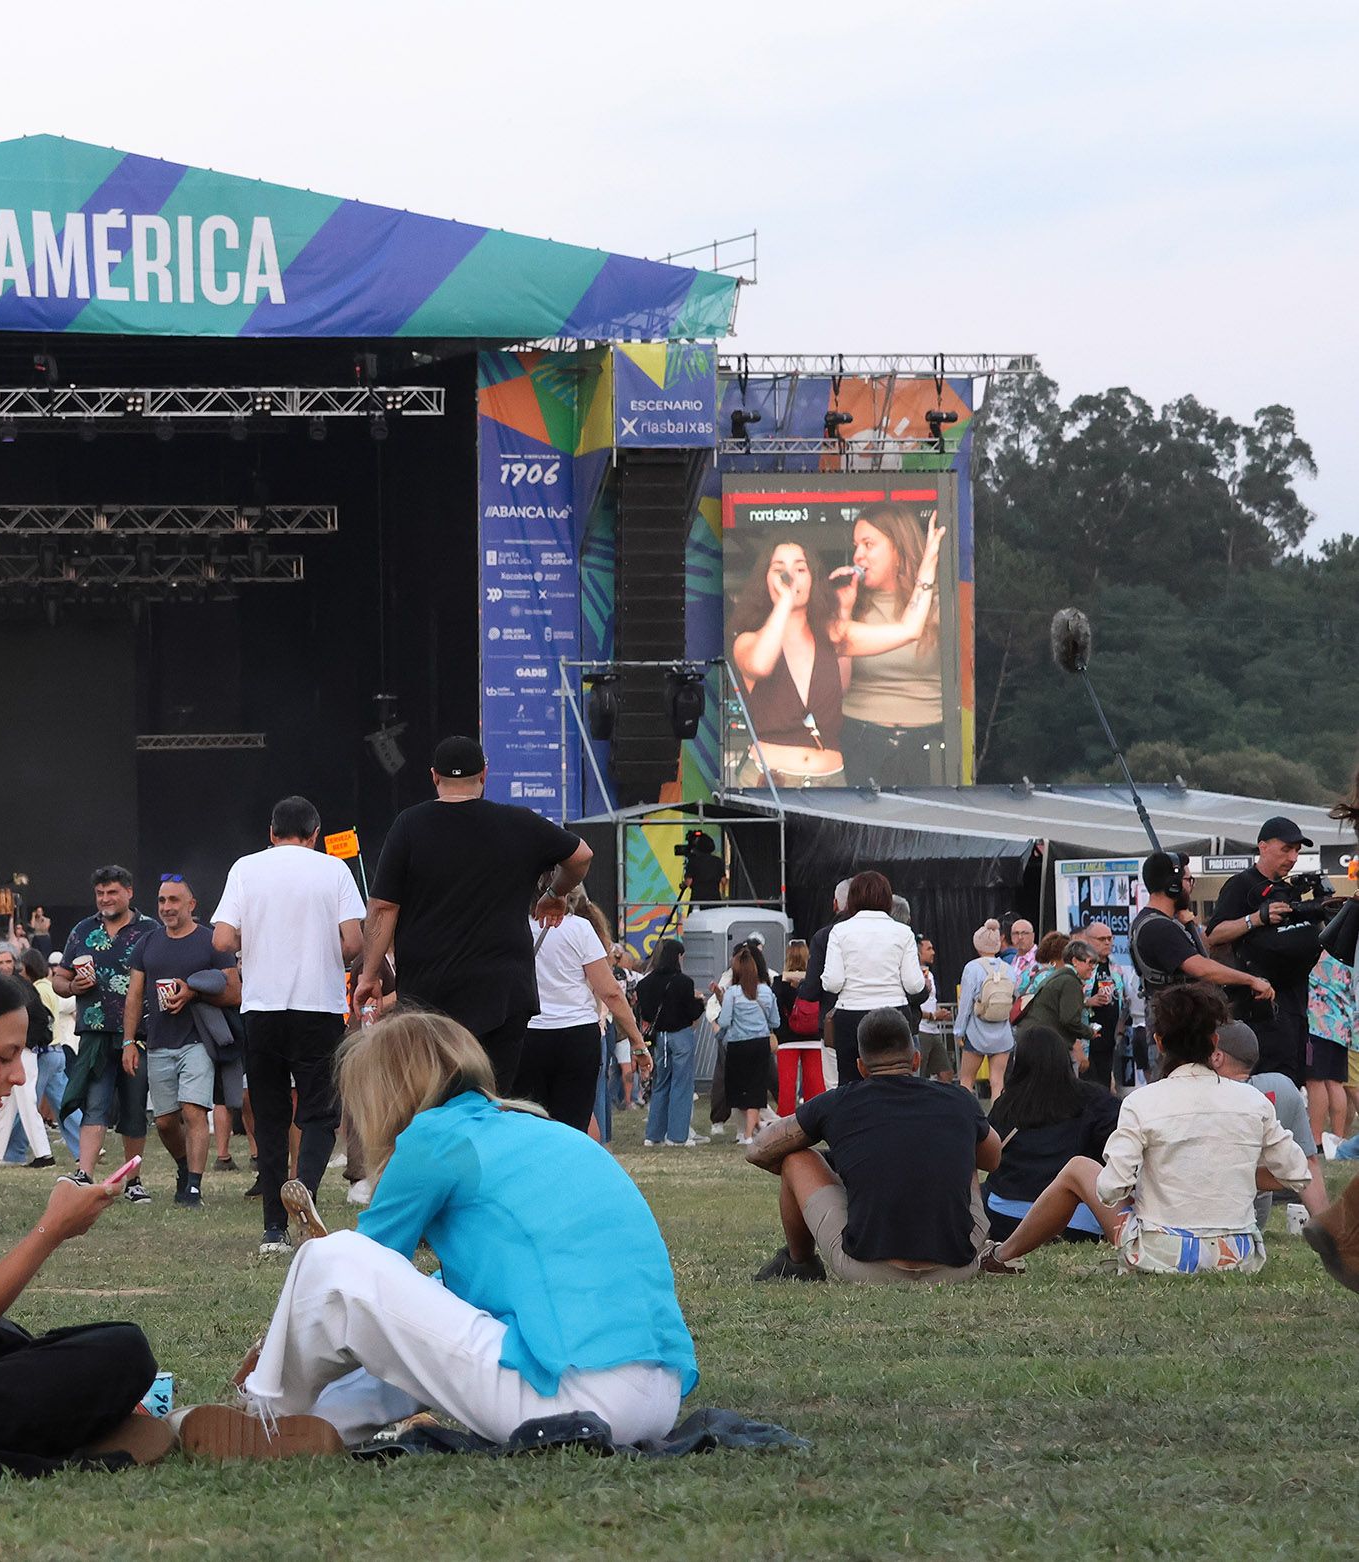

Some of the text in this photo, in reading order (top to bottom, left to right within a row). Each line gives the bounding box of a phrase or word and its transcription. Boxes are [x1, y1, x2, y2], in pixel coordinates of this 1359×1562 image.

[630, 400, 703, 411] ESCENARIO
[641, 420, 713, 434] riasbaixas
[500, 462, 560, 487] 1906
